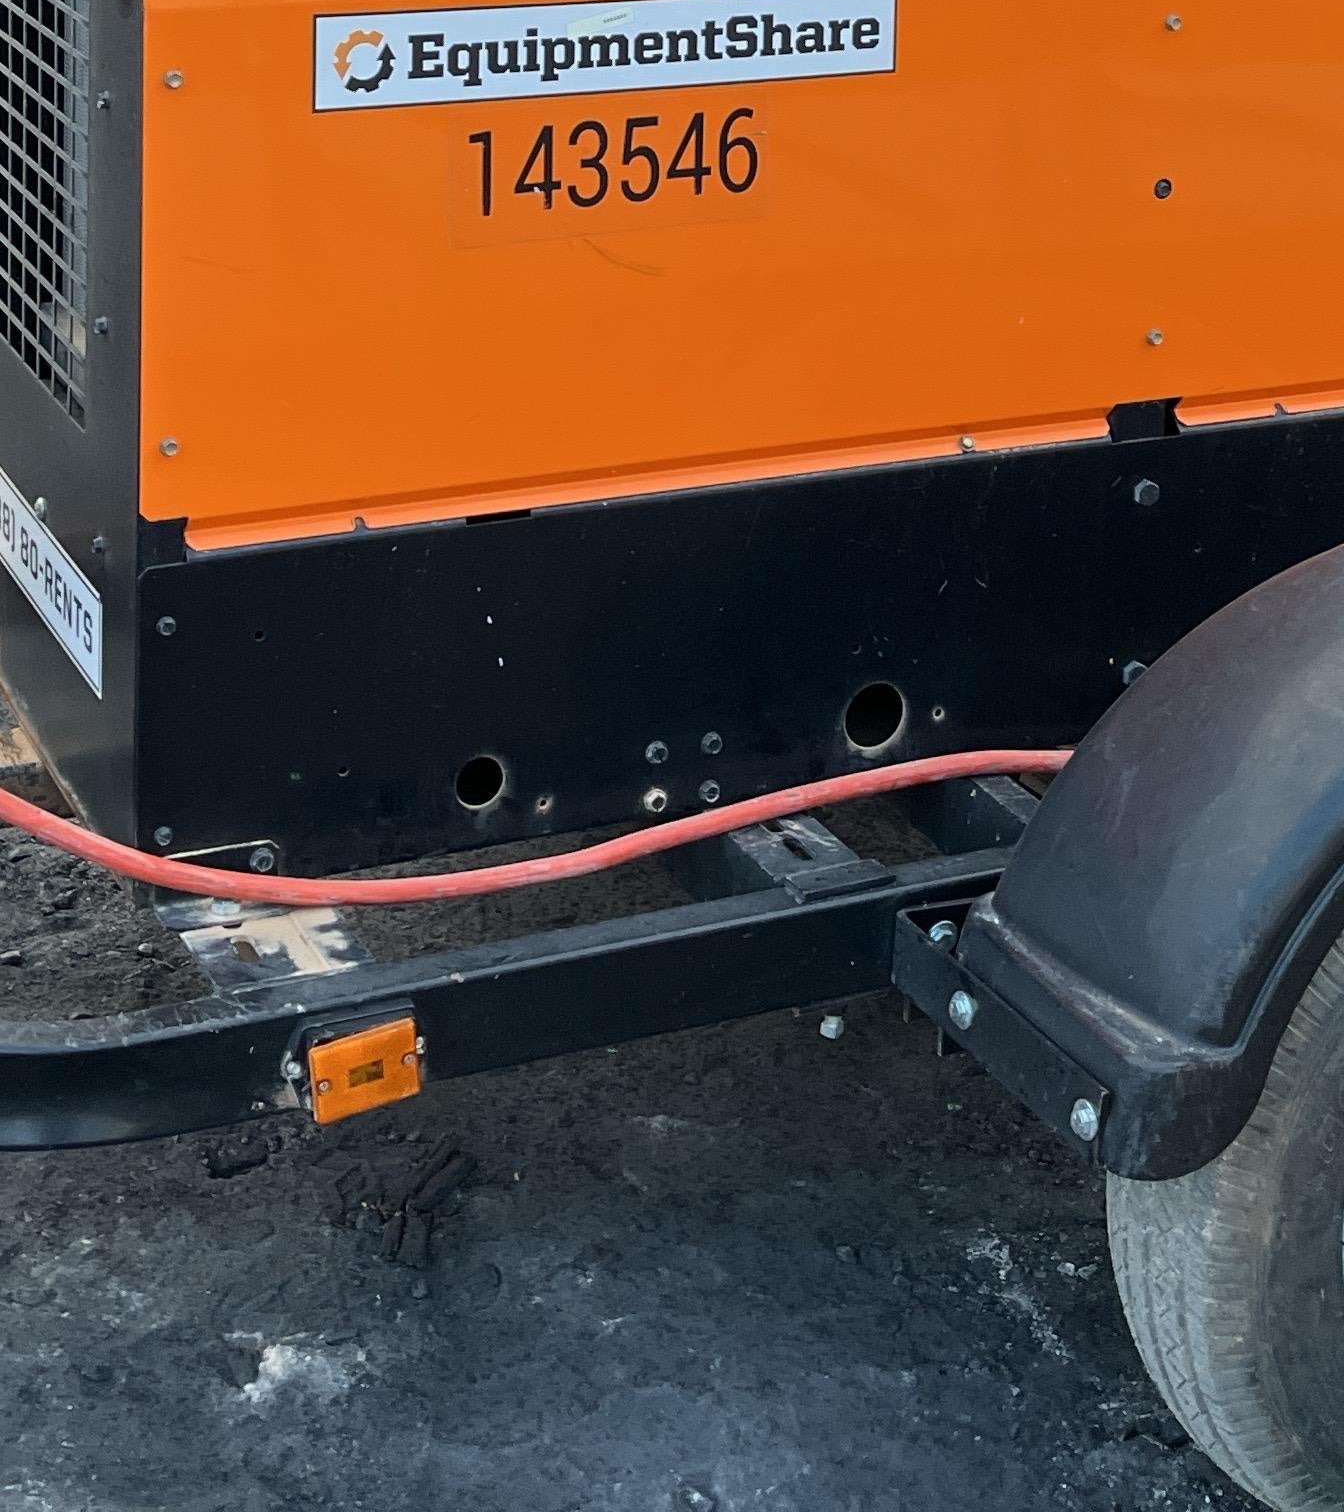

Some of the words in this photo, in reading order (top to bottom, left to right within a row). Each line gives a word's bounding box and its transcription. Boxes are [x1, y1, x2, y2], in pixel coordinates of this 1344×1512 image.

[407, 13, 880, 87] EquipmentShare
[467, 106, 759, 217] 143546
[19, 524, 94, 656] 80-RENTS
